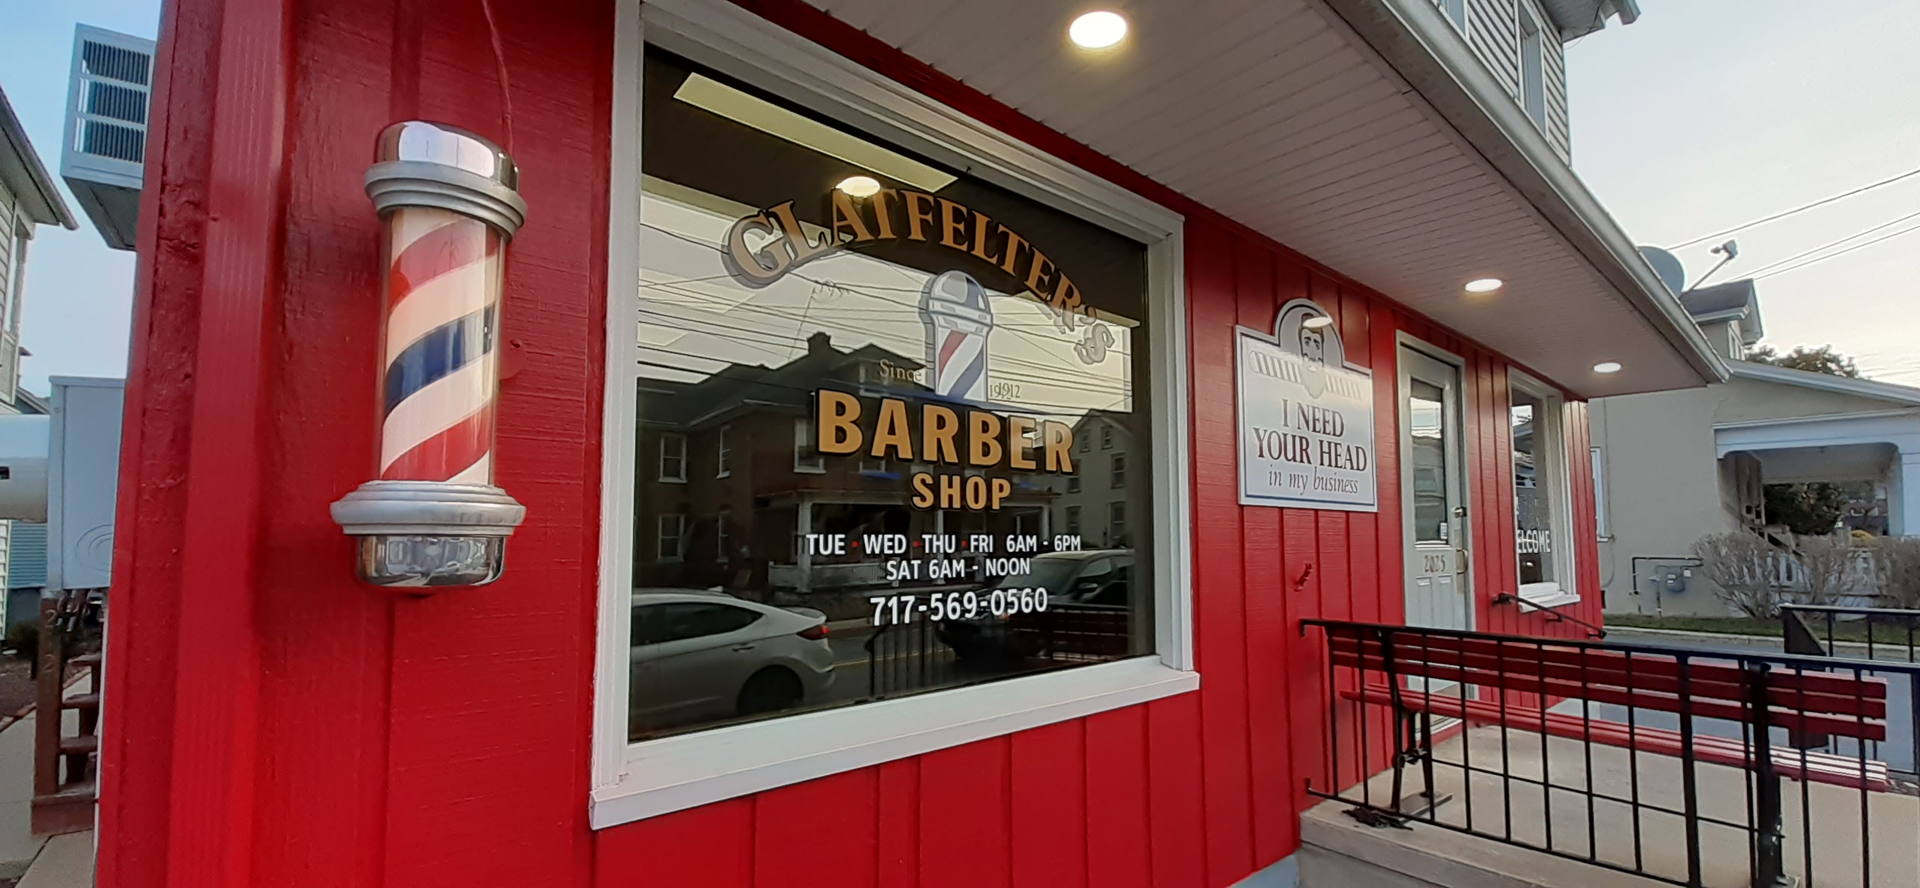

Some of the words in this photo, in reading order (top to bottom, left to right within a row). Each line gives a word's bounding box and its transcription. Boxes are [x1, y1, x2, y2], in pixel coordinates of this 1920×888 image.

[878, 358, 923, 382] Since
[816, 388, 1074, 474] BARBER
[1281, 398, 1290, 428] I
[1296, 401, 1345, 438] NEED
[1252, 427, 1312, 465] YOUR
[1319, 439, 1368, 472] HEAD
[911, 472, 1012, 511] SHOP
[1268, 464, 1283, 487] in
[1288, 472, 1309, 496] my
[1313, 466, 1359, 494] business
[806, 533, 846, 556] TUE
[863, 533, 907, 555] WED
[921, 534, 956, 554] THU
[969, 534, 994, 554] FRI
[1005, 534, 1038, 553] 6AM
[1053, 534, 1081, 552] 6PM
[1516, 530, 1551, 553] ELCOME
[886, 559, 921, 580] SAT
[928, 558, 966, 578] 6AM
[985, 557, 1031, 577] NOON
[870, 586, 1049, 627] 717-569-0560
